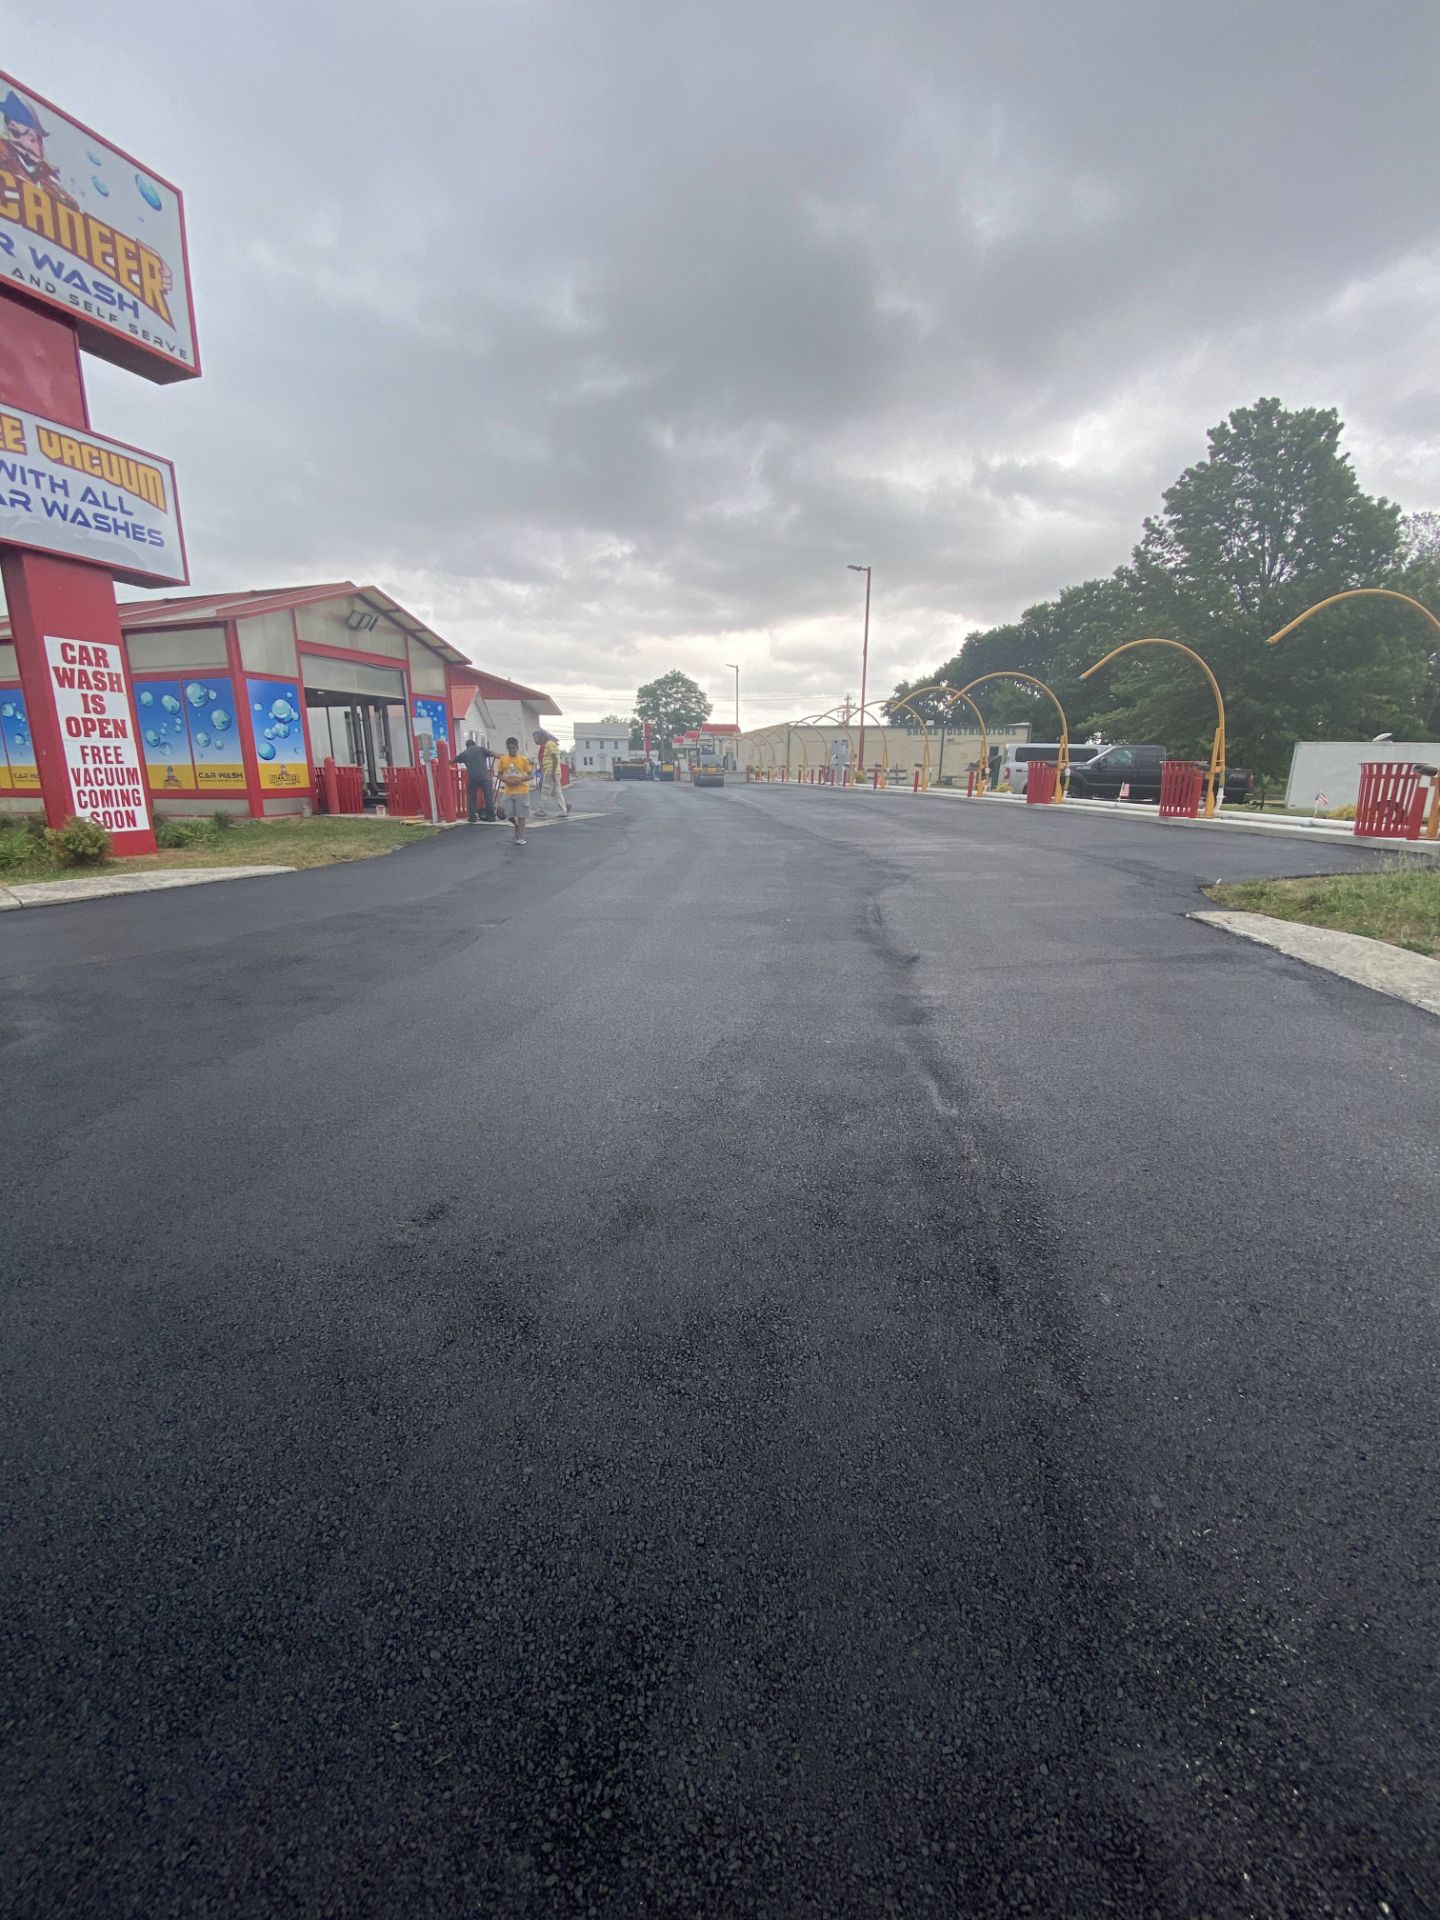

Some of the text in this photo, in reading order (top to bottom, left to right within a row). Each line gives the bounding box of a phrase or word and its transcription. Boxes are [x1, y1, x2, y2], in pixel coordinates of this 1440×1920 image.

[29, 246, 139, 319] WASH
[12, 267, 187, 360] AND SELF SERVE
[36, 425, 168, 514] VACUUM
[80, 486, 134, 516] ALL
[41, 497, 165, 547] WASHES
[60, 643, 109, 668] CAR
[52, 667, 124, 693] WASH
[81, 693, 106, 715] IS
[66, 717, 128, 739] OPEN
[80, 745, 124, 764] FREE
[71, 768, 140, 787] VACUUM
[77, 788, 142, 809] COMING
[90, 810, 137, 829] SOON
